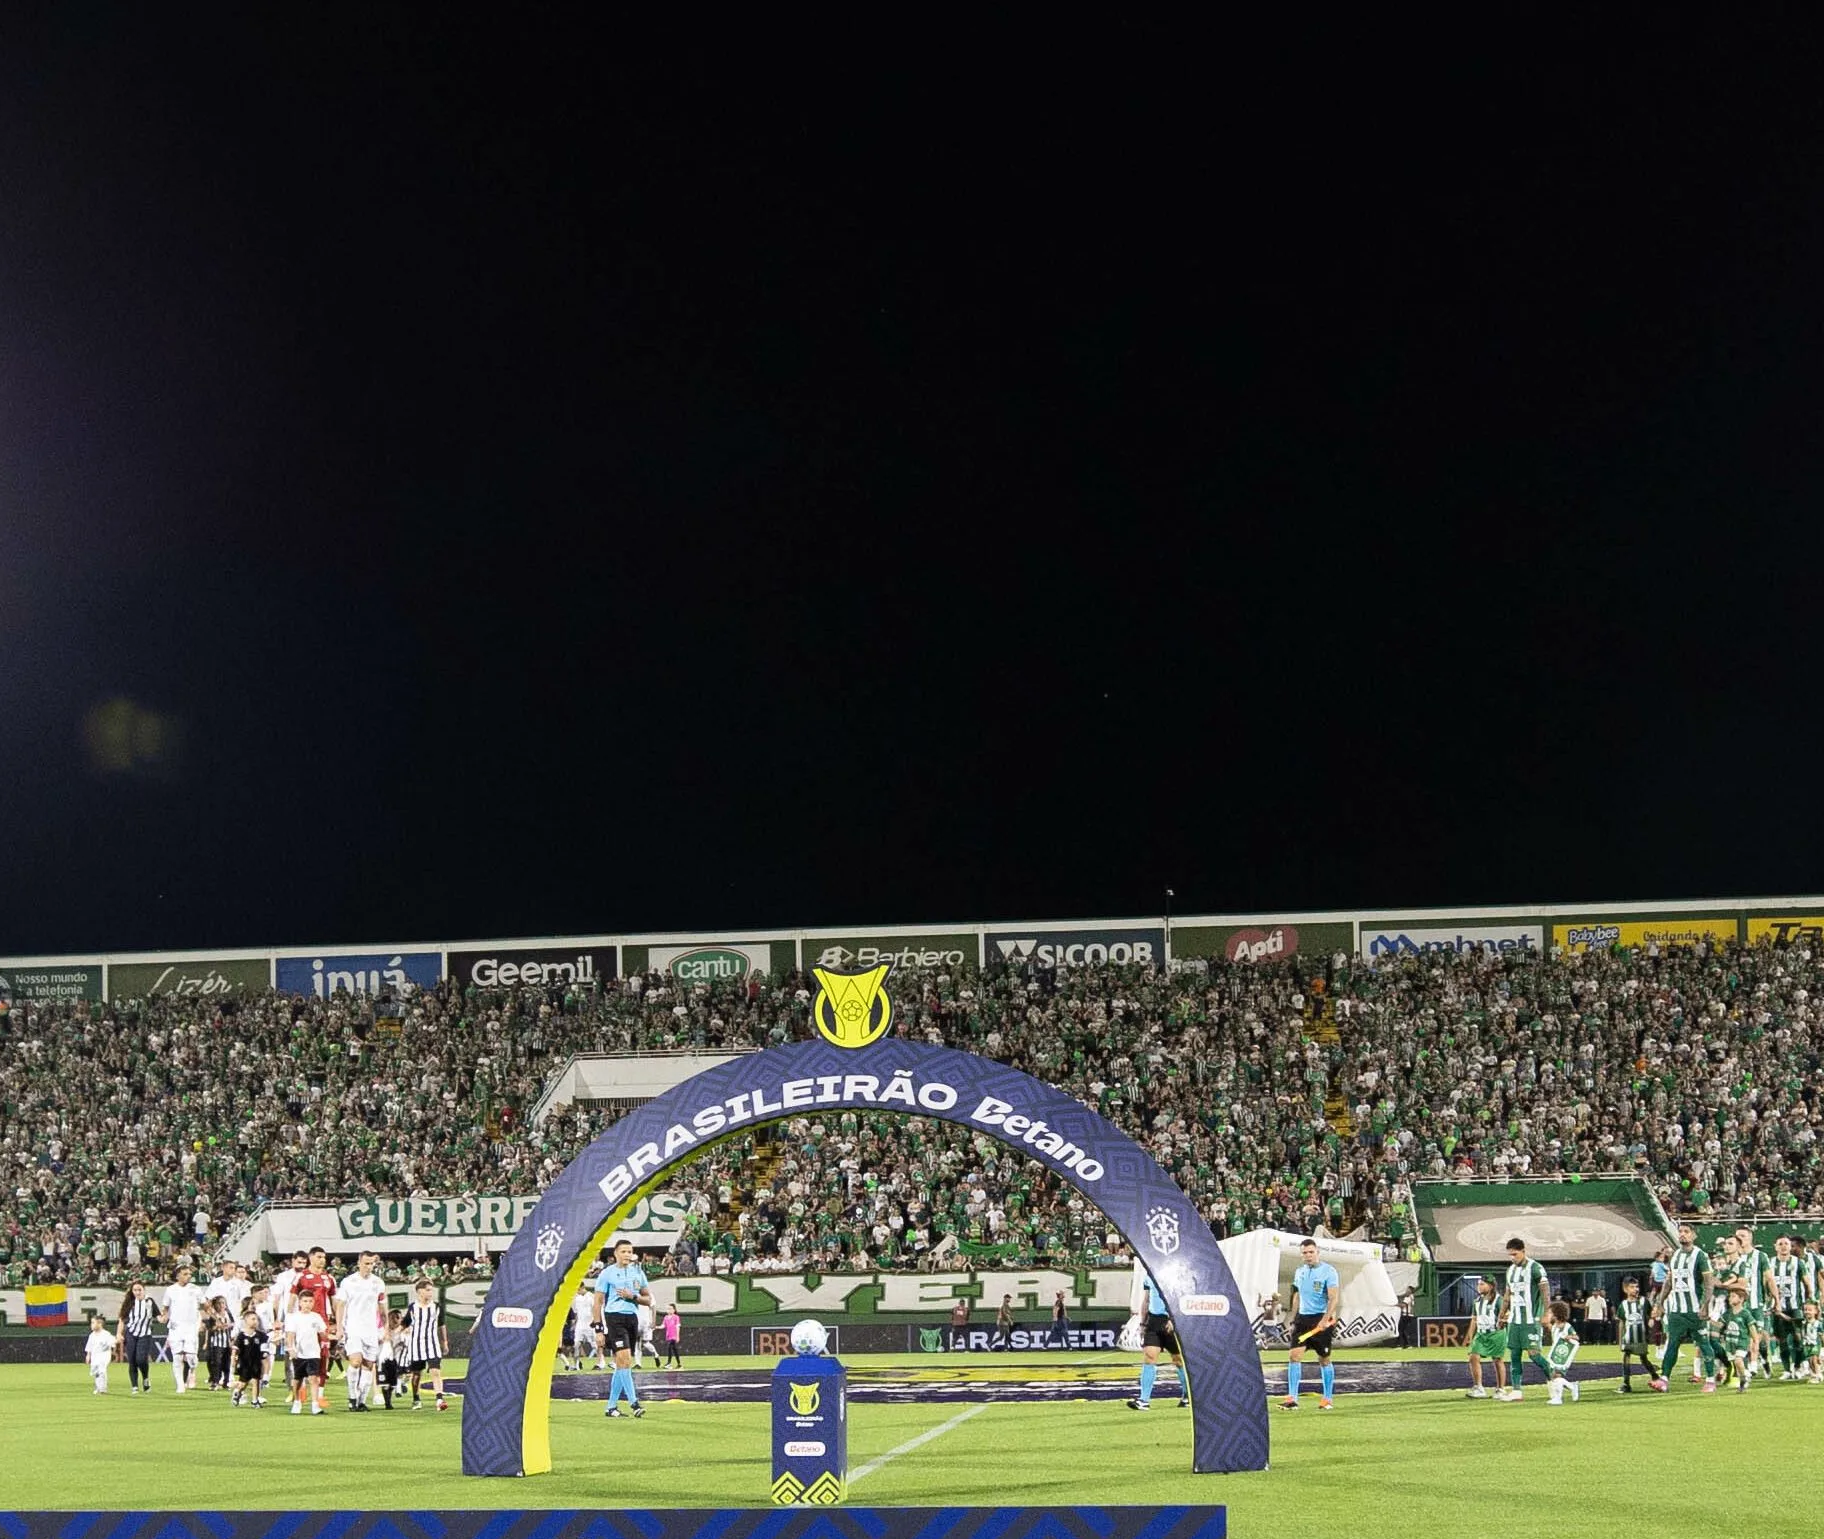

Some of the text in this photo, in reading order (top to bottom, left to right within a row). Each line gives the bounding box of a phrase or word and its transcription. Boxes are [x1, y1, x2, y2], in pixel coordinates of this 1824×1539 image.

[858, 946, 964, 968] Barbiero
[1036, 942, 1153, 969] SICOOB
[1234, 930, 1283, 963] Apti
[1423, 934, 1537, 956] mhnet
[15, 971, 88, 985] Nosso mundo
[471, 956, 593, 987] Geemil
[677, 956, 740, 980] cantu
[35, 984, 84, 998] telefonia
[598, 1069, 1106, 1203] BRASILEIRÃO Betano
